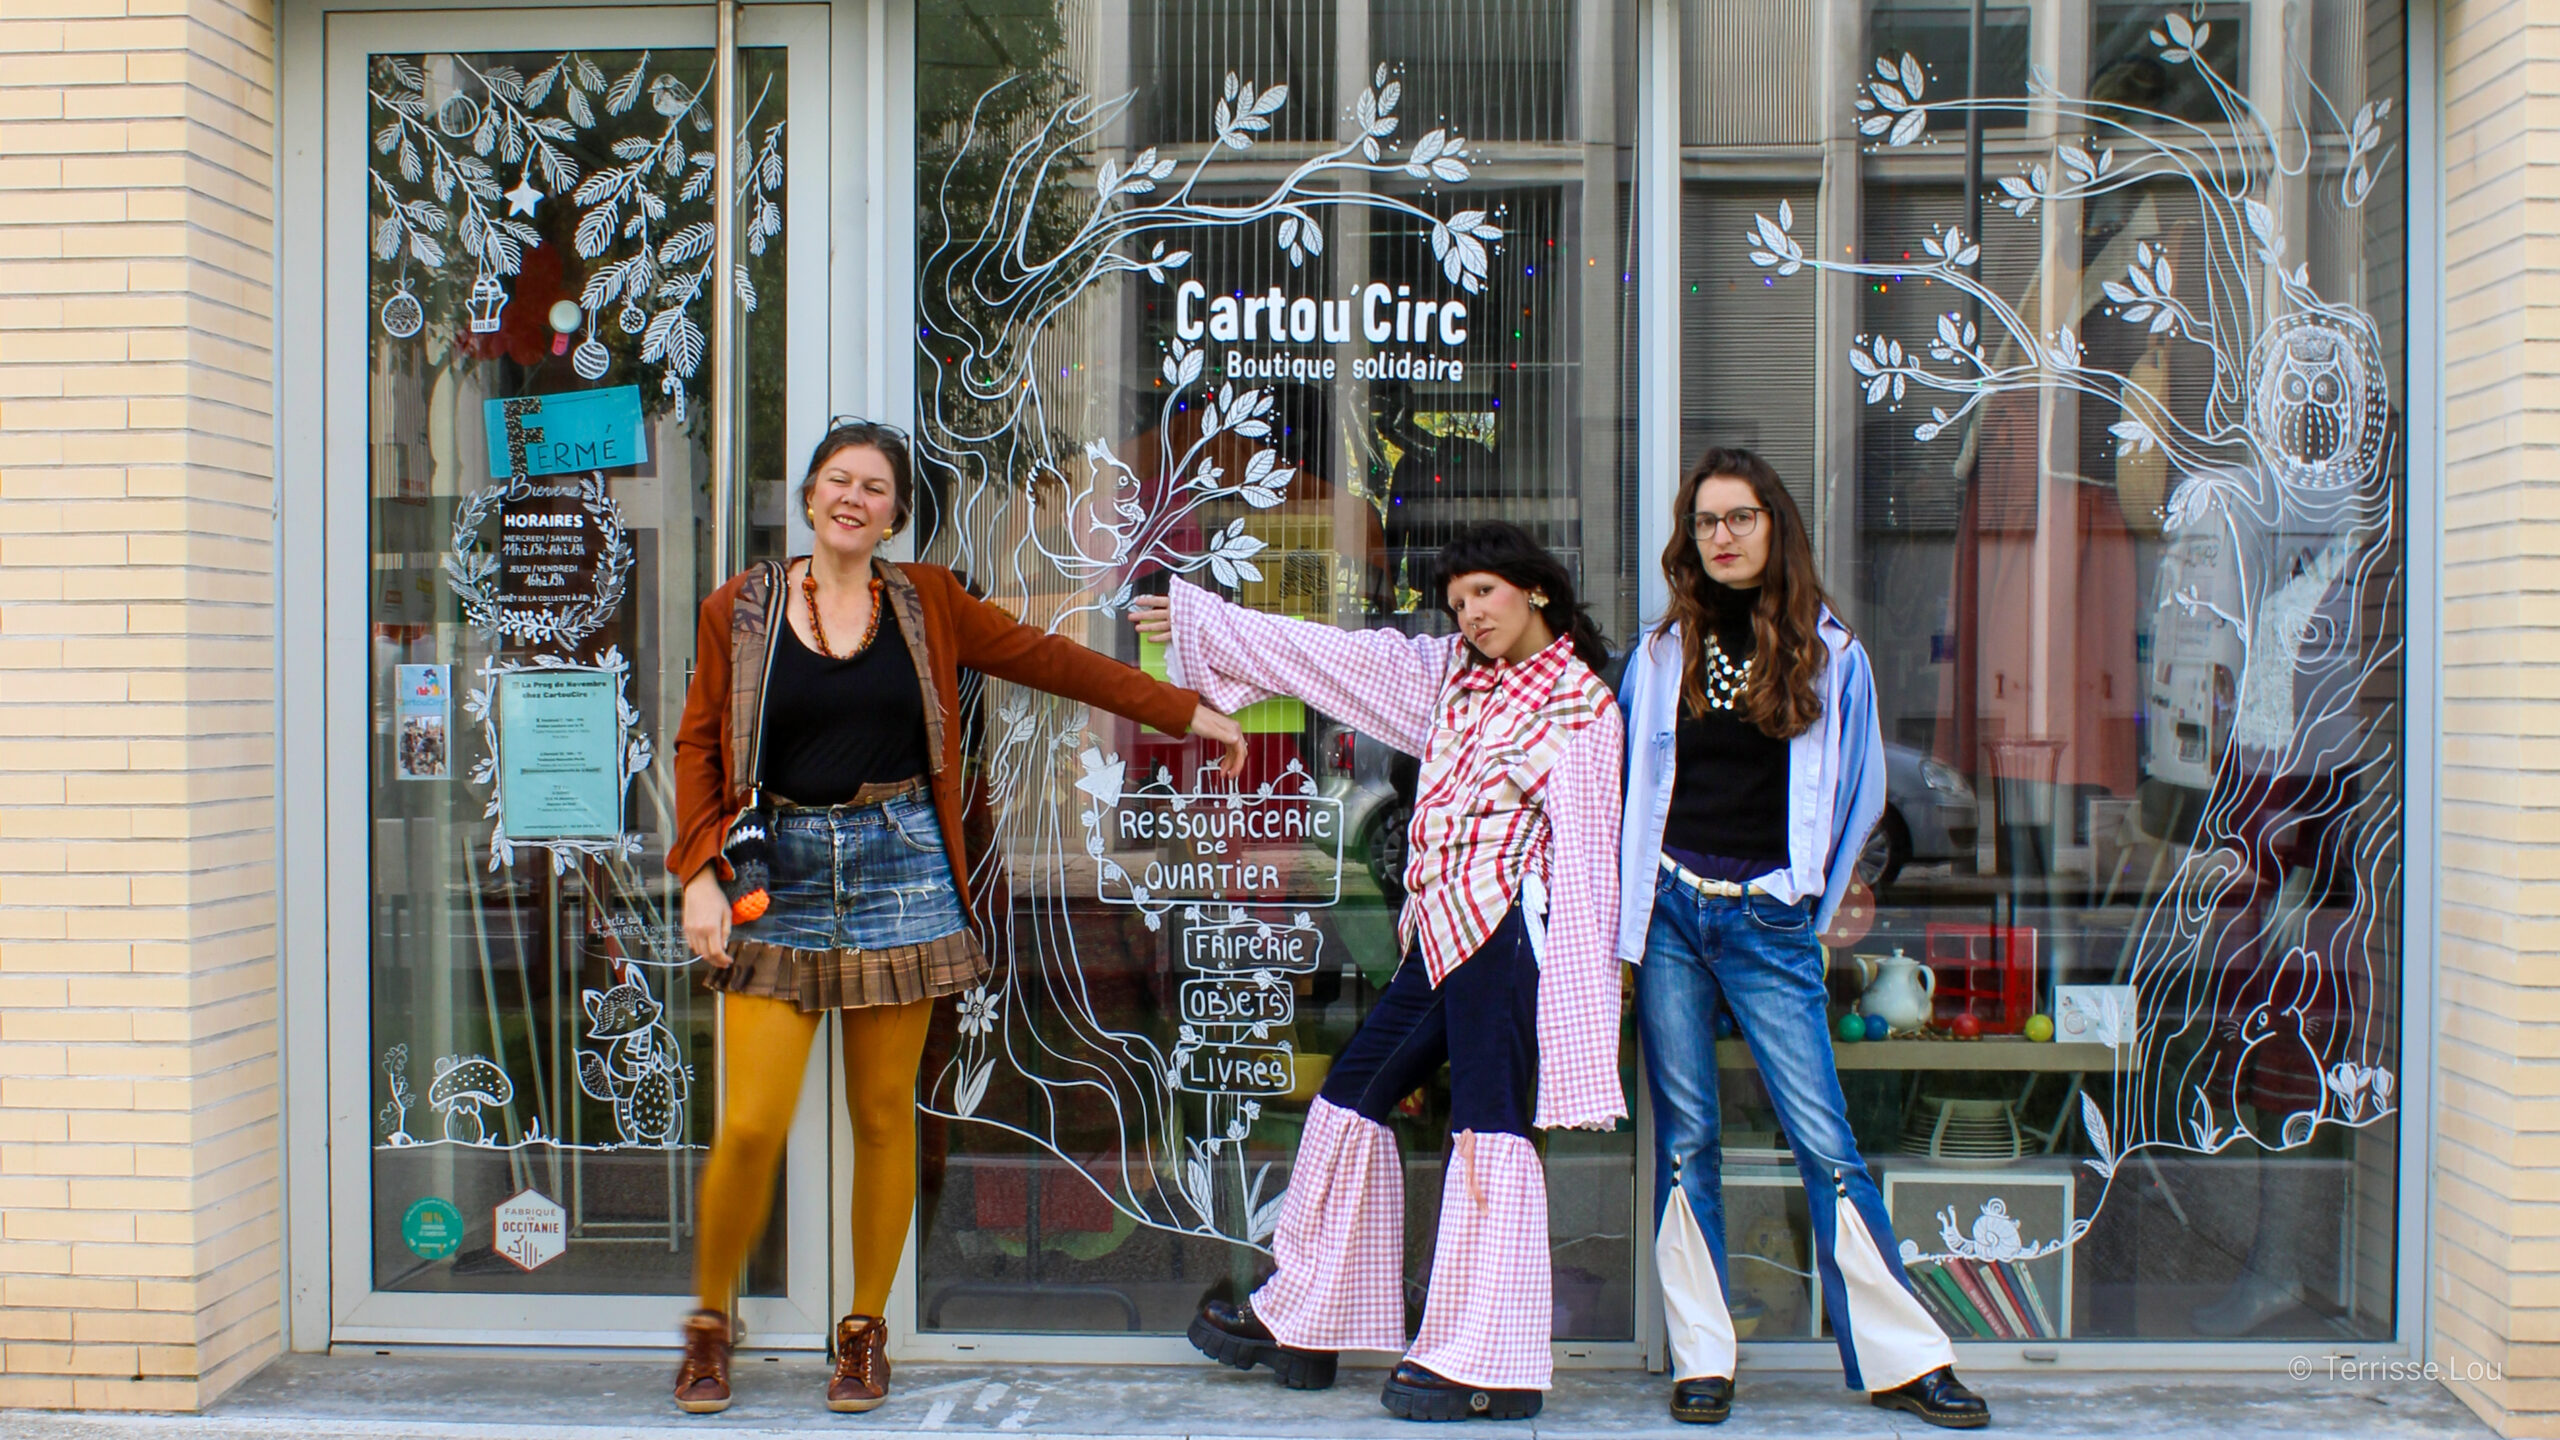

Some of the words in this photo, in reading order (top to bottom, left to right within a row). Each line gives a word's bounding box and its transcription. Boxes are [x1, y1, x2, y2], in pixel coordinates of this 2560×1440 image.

[1176, 280, 1467, 345] Cartou'Circ
[1227, 350, 1335, 384] Boutique
[1352, 351, 1464, 381] solidaire
[503, 396, 617, 478] FERMÉ
[504, 513, 584, 528] HORAIRES
[502, 1221, 559, 1233] OCCITANIE
